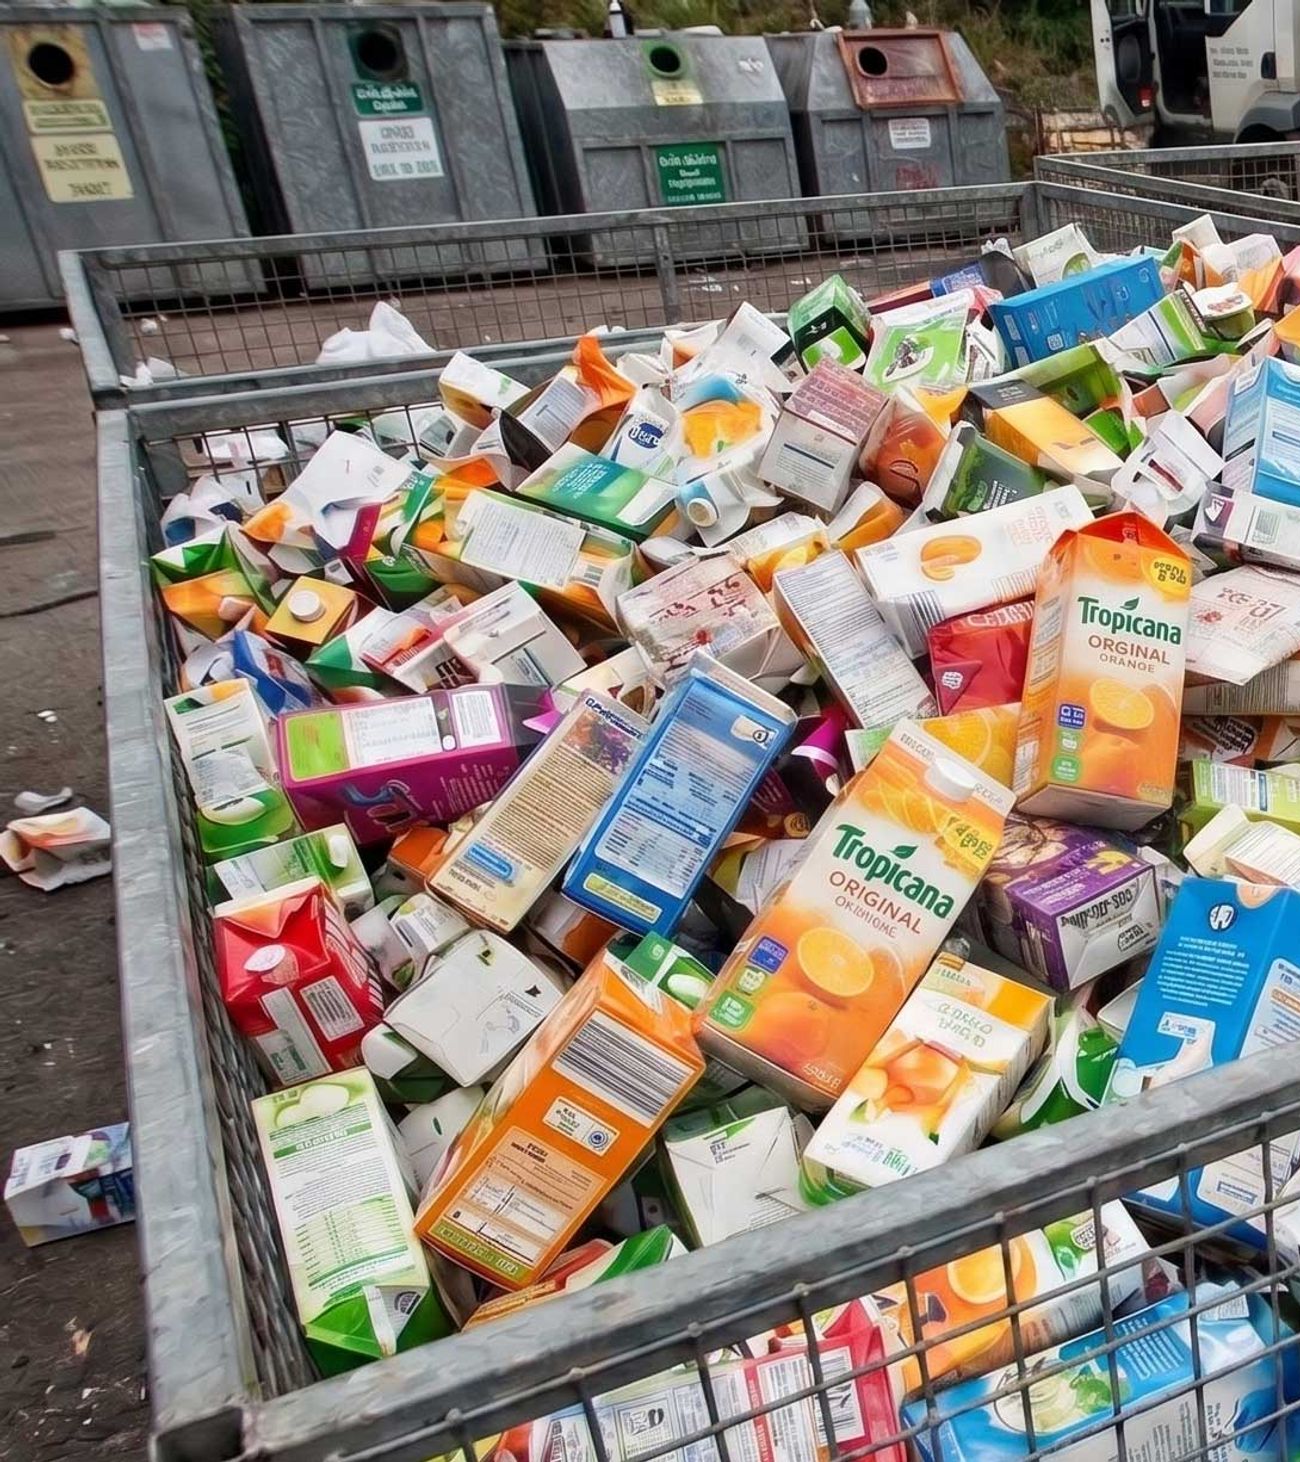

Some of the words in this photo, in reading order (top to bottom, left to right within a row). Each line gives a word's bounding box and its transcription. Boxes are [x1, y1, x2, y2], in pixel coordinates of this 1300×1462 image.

[1077, 596, 1182, 645] Tropicana
[1088, 634, 1170, 665] ORGINAL
[1099, 653, 1155, 673] ORANGE
[832, 823, 954, 919] Tropicana
[829, 871, 921, 934] ORIGINAL
